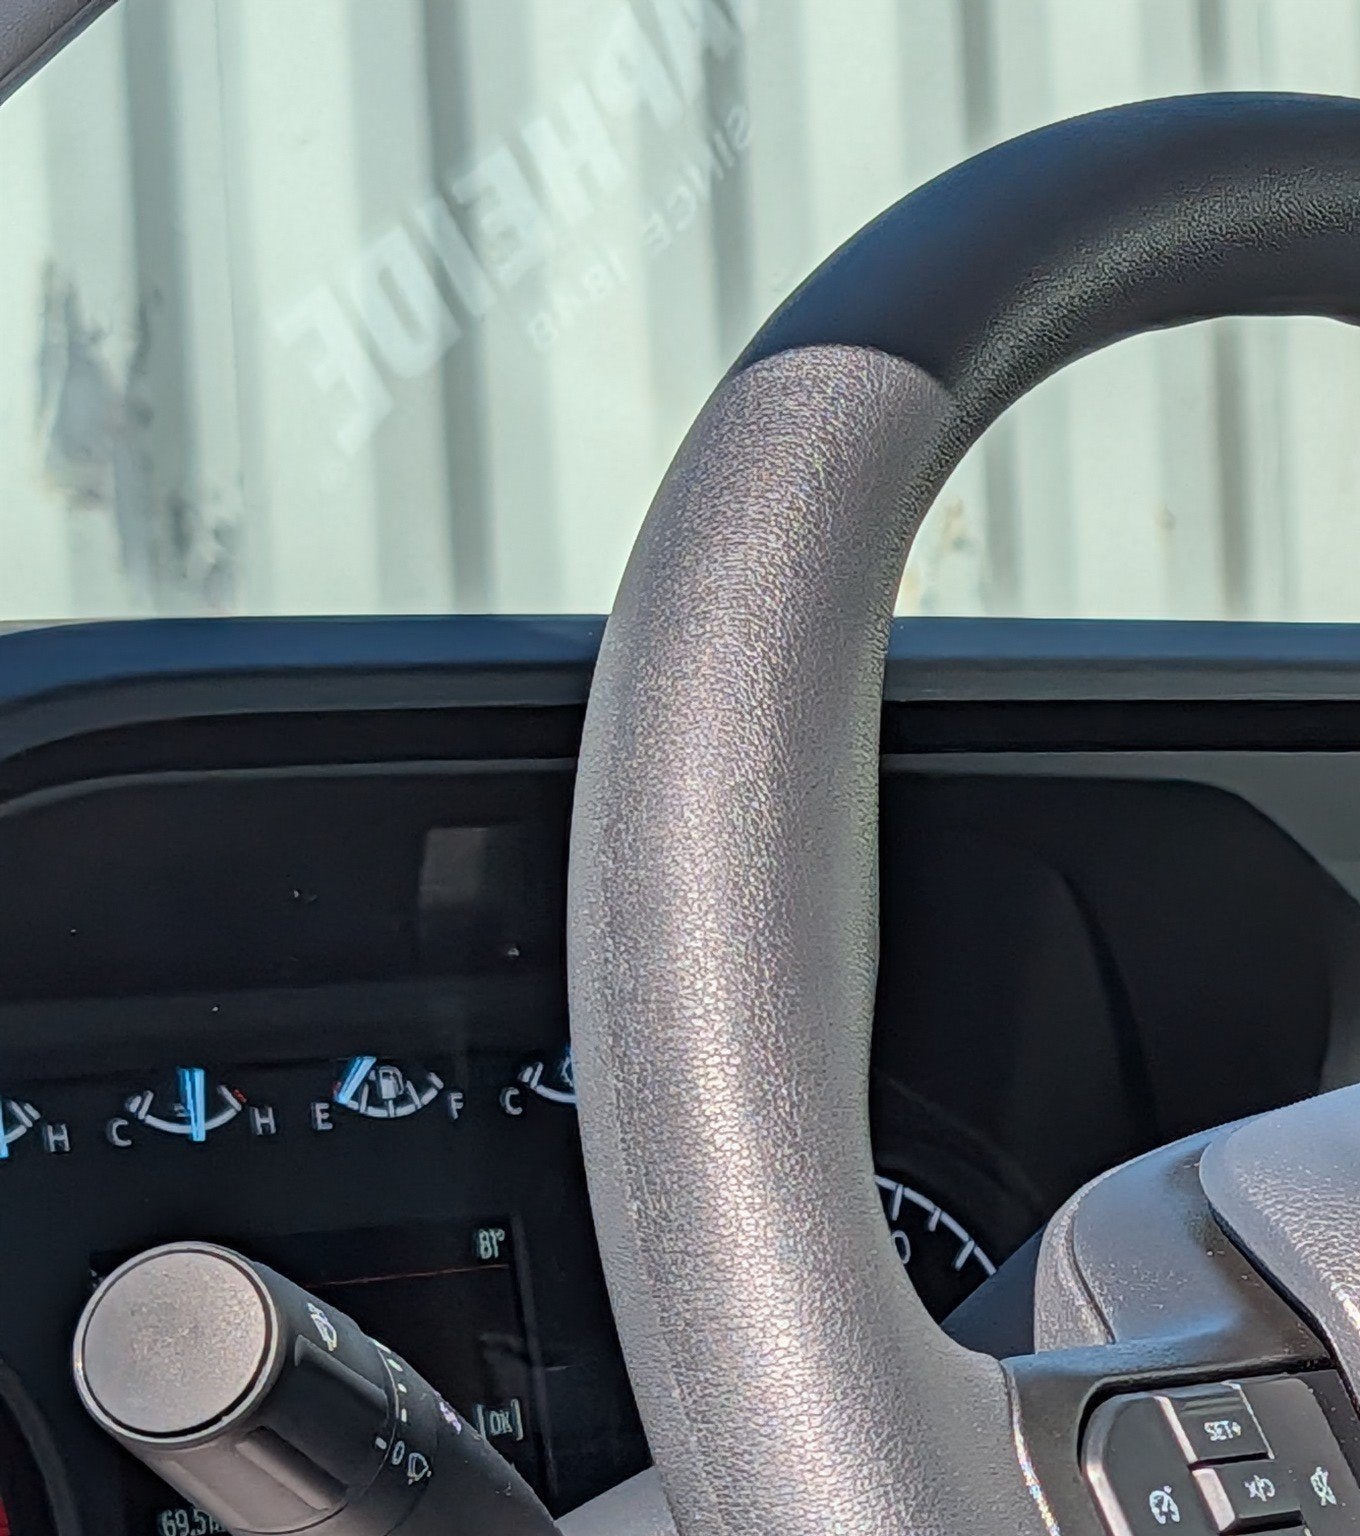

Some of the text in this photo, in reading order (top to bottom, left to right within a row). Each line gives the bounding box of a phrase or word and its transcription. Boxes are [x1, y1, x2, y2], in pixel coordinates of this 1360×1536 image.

[311, 1091, 464, 1131] E F
[499, 1086, 523, 1116] C
[107, 1106, 277, 1147] C H
